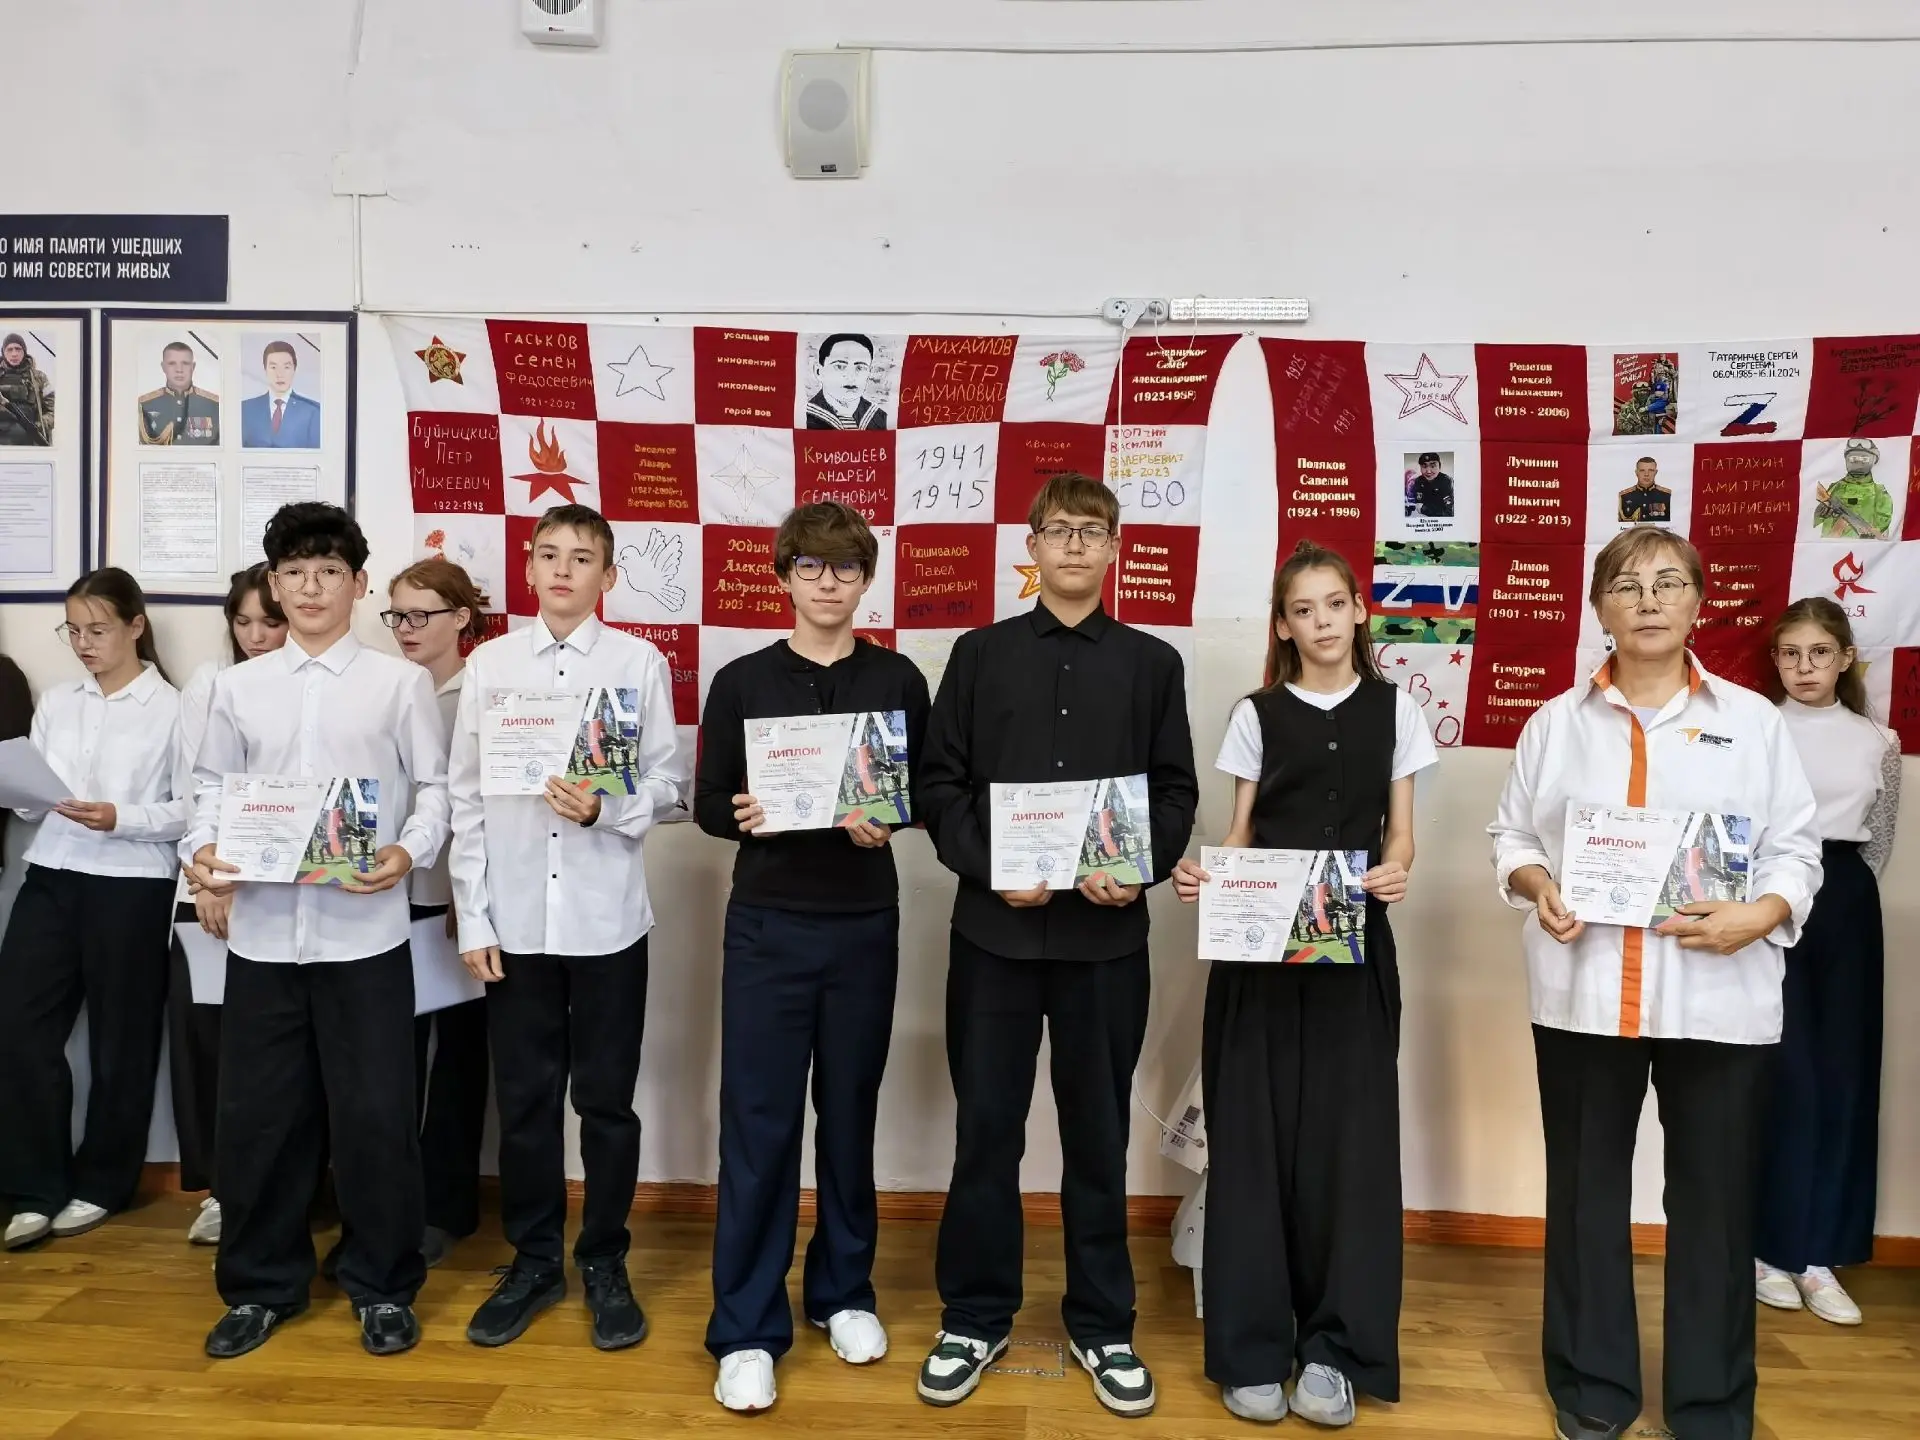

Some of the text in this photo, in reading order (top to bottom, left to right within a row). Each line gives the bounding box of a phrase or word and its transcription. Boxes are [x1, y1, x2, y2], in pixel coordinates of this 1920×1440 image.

[13, 238, 45, 255] ИМЯ
[50, 238, 106, 255] ПАМЯТИ
[112, 238, 183, 258] УШЕДШИХ
[13, 261, 44, 278] ИМЯ
[50, 262, 111, 279] СОВЕСТИ
[117, 262, 171, 279] ЖИВЫХ
[504, 332, 579, 350] ГАСЬКОВ
[911, 336, 1013, 356] МИХАЙЛОВ
[1510, 375, 1553, 385] Алексей
[901, 382, 1007, 404] САМУИЛОВИЧ
[1500, 387, 1563, 398] Николаевич
[909, 405, 995, 424] 1923-2000
[1494, 405, 1527, 418] (1918
[1537, 406, 1570, 420] 2006)
[413, 416, 499, 449] Буйницкий
[915, 443, 985, 470] 1941
[1506, 456, 1560, 469] Лучинин
[1297, 457, 1347, 471] Поляков
[816, 465, 877, 483] АНДРЕЙ
[1299, 474, 1350, 486] Савелий
[1508, 476, 1560, 489] Николай
[911, 480, 990, 510] 1945
[1292, 490, 1357, 503] Сидорович
[1508, 495, 1561, 508] Никитич
[1287, 507, 1319, 519] (1924
[1330, 507, 1361, 519] 1996)
[1495, 513, 1528, 525] (1922
[727, 538, 771, 554] Юдин
[1132, 543, 1169, 555] Петров
[915, 563, 956, 577] Павел
[1125, 559, 1169, 572] Николай
[1510, 559, 1550, 572] Димов
[1121, 574, 1172, 587] Маркович
[1507, 574, 1551, 588] Виктор
[1492, 588, 1564, 602] Васильевич
[718, 598, 744, 610] 1903
[755, 600, 782, 613] 1942
[1488, 608, 1520, 619] (1901
[501, 716, 555, 727] ДИПЛОМ
[767, 747, 822, 760] ДИПЛОМ
[242, 803, 295, 814] ДИПЛОМ
[1011, 811, 1064, 822] ДИПЛОМ
[1587, 836, 1646, 850] ДИПЛОМ
[1221, 879, 1278, 890] ДИПЛОМ
